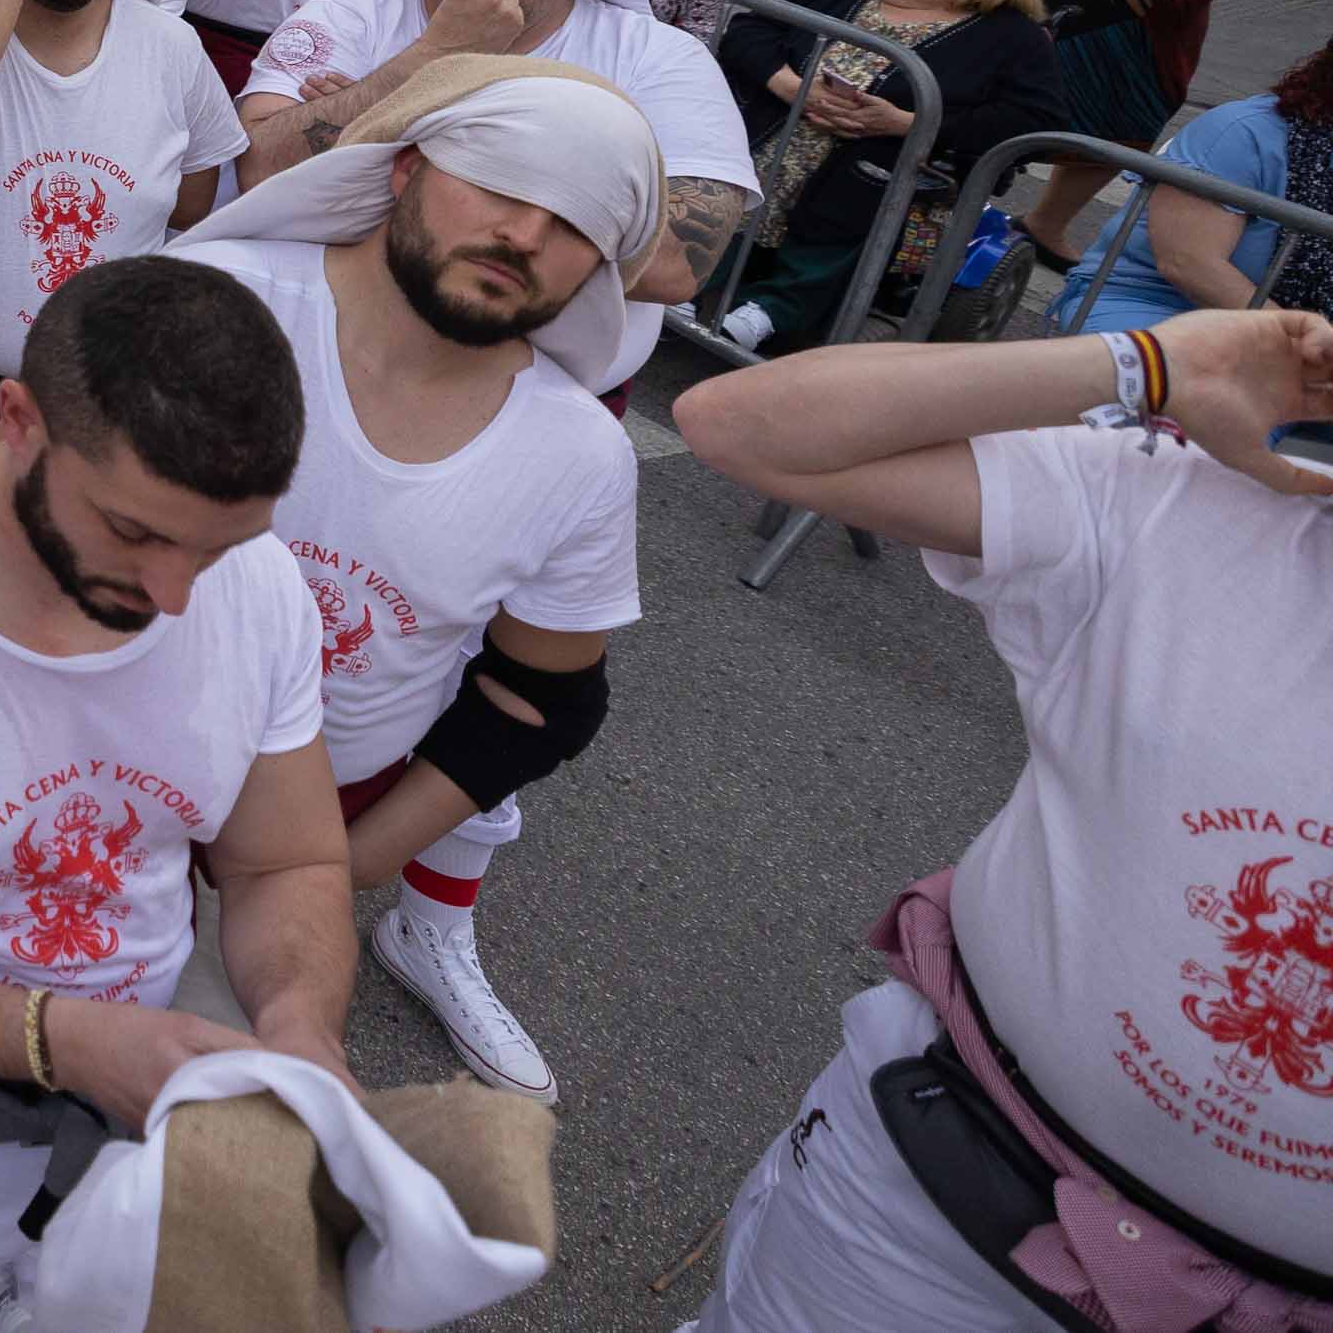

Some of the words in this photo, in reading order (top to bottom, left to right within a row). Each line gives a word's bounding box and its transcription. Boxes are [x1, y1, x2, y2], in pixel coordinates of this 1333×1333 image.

[2, 158, 35, 193] SANTA
[68, 150, 77, 163] Y
[80, 151, 137, 193] VICTORIA
[288, 539, 340, 570] CENA
[347, 558, 366, 577] Y
[364, 568, 421, 638] VICTORI
[23, 762, 82, 804] CENA
[89, 759, 105, 778] Y
[114, 763, 206, 830] VICTORIA
[1181, 807, 1286, 837] SANTA
[1111, 1049, 1184, 1123] SOMOS
[1191, 1118, 1208, 1136] Y
[1114, 1010, 1151, 1056] POR
[1148, 1058, 1191, 1099] LOS
[1195, 1097, 1250, 1137] QUE
[1204, 1077, 1258, 1115] 1979
